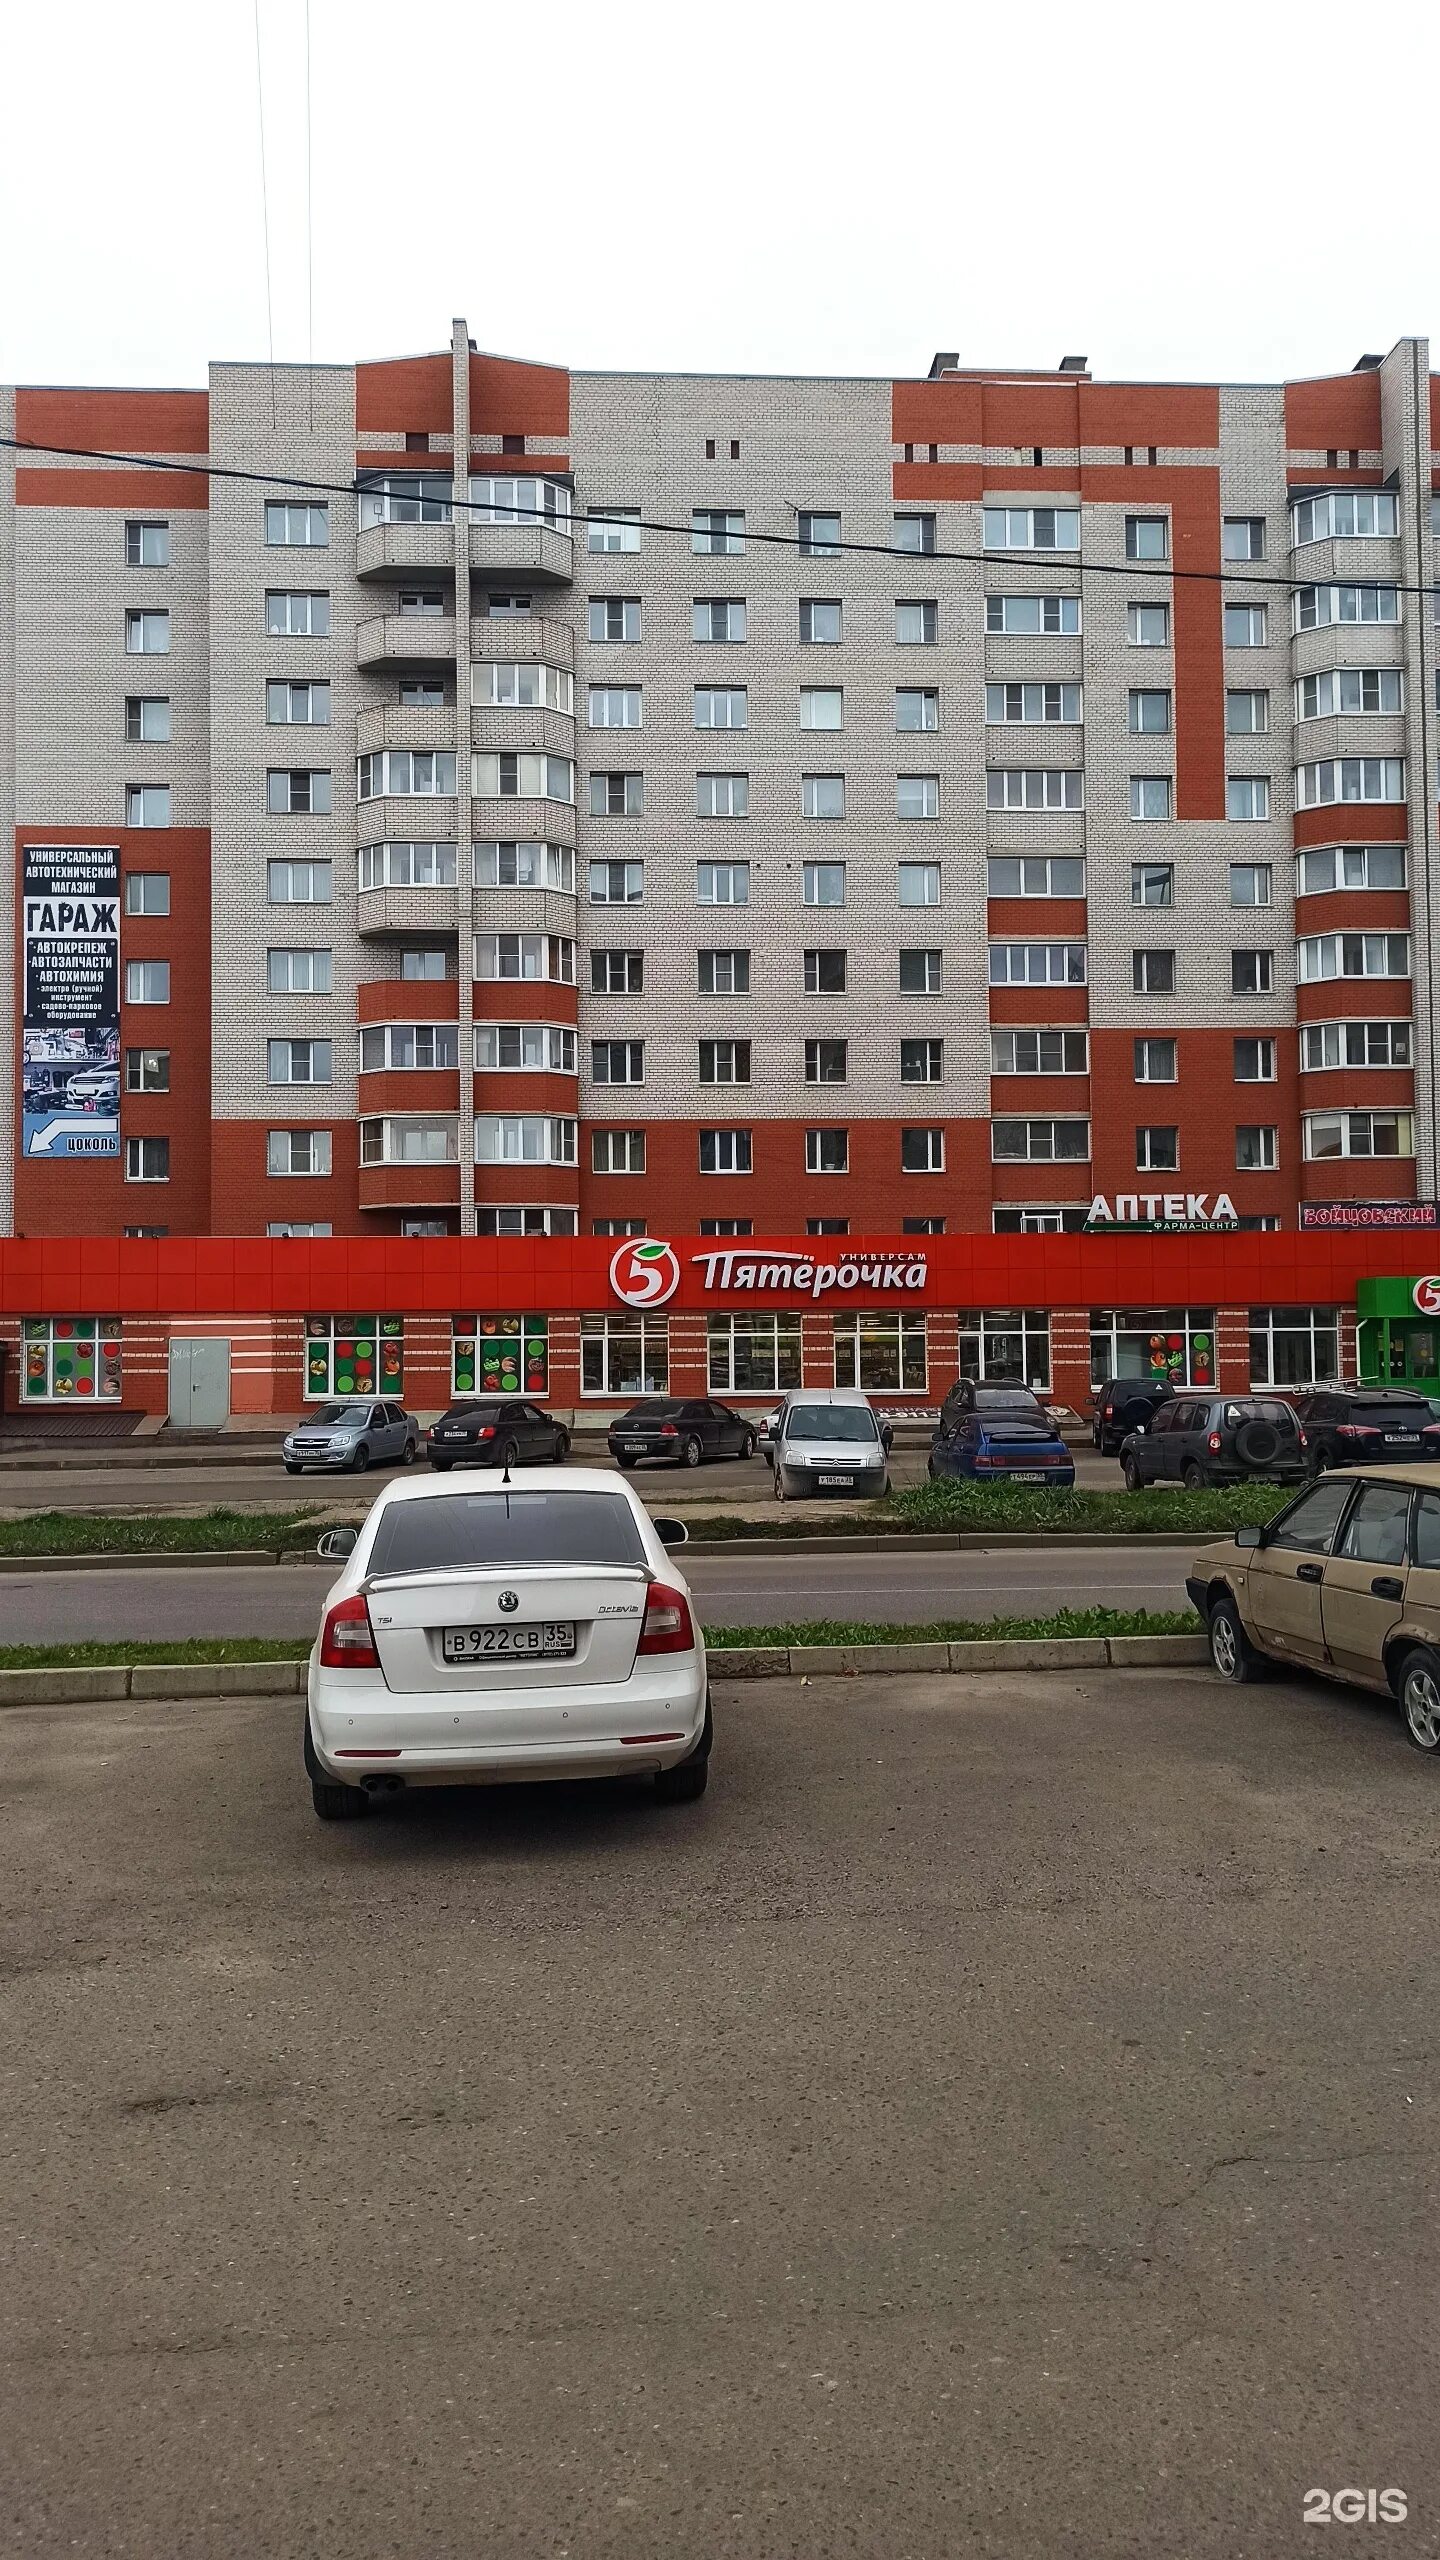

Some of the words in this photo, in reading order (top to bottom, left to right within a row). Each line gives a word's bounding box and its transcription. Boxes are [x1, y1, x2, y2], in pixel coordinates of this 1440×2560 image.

[30, 850, 114, 863] УНИВЕРСАЛЬНЫЙ
[26, 865, 117, 878] АВТОТЕХНИЧЕСКИЙ
[51, 881, 96, 893] МАГАЗИН
[27, 902, 118, 932] ГАРАЖ
[37, 942, 107, 954] АВТОКРЕПЕЖ
[31, 956, 112, 968] АВТОЗАПЧАСТИ
[39, 970, 104, 982] АВТОХИМИЯ
[40, 985, 70, 993] электро
[51, 994, 93, 1002] инструмент
[41, 1003, 102, 1011] садово-парковое
[46, 1011, 97, 1020] оборудование
[67, 1137, 116, 1152] ЦОКОЛЬ
[1086, 1194, 1239, 1221] АПТЕКА
[1304, 1204, 1436, 1226] БОЙЦОВСКИЙ
[1153, 1222, 1238, 1230] ФАРМА-ЦЕНТР
[840, 1253, 926, 1261] УНИВЕРСАМ
[624, 1258, 663, 1300] 5
[688, 1250, 927, 1298] Пятёрочка
[545, 1625, 567, 1641] 35
